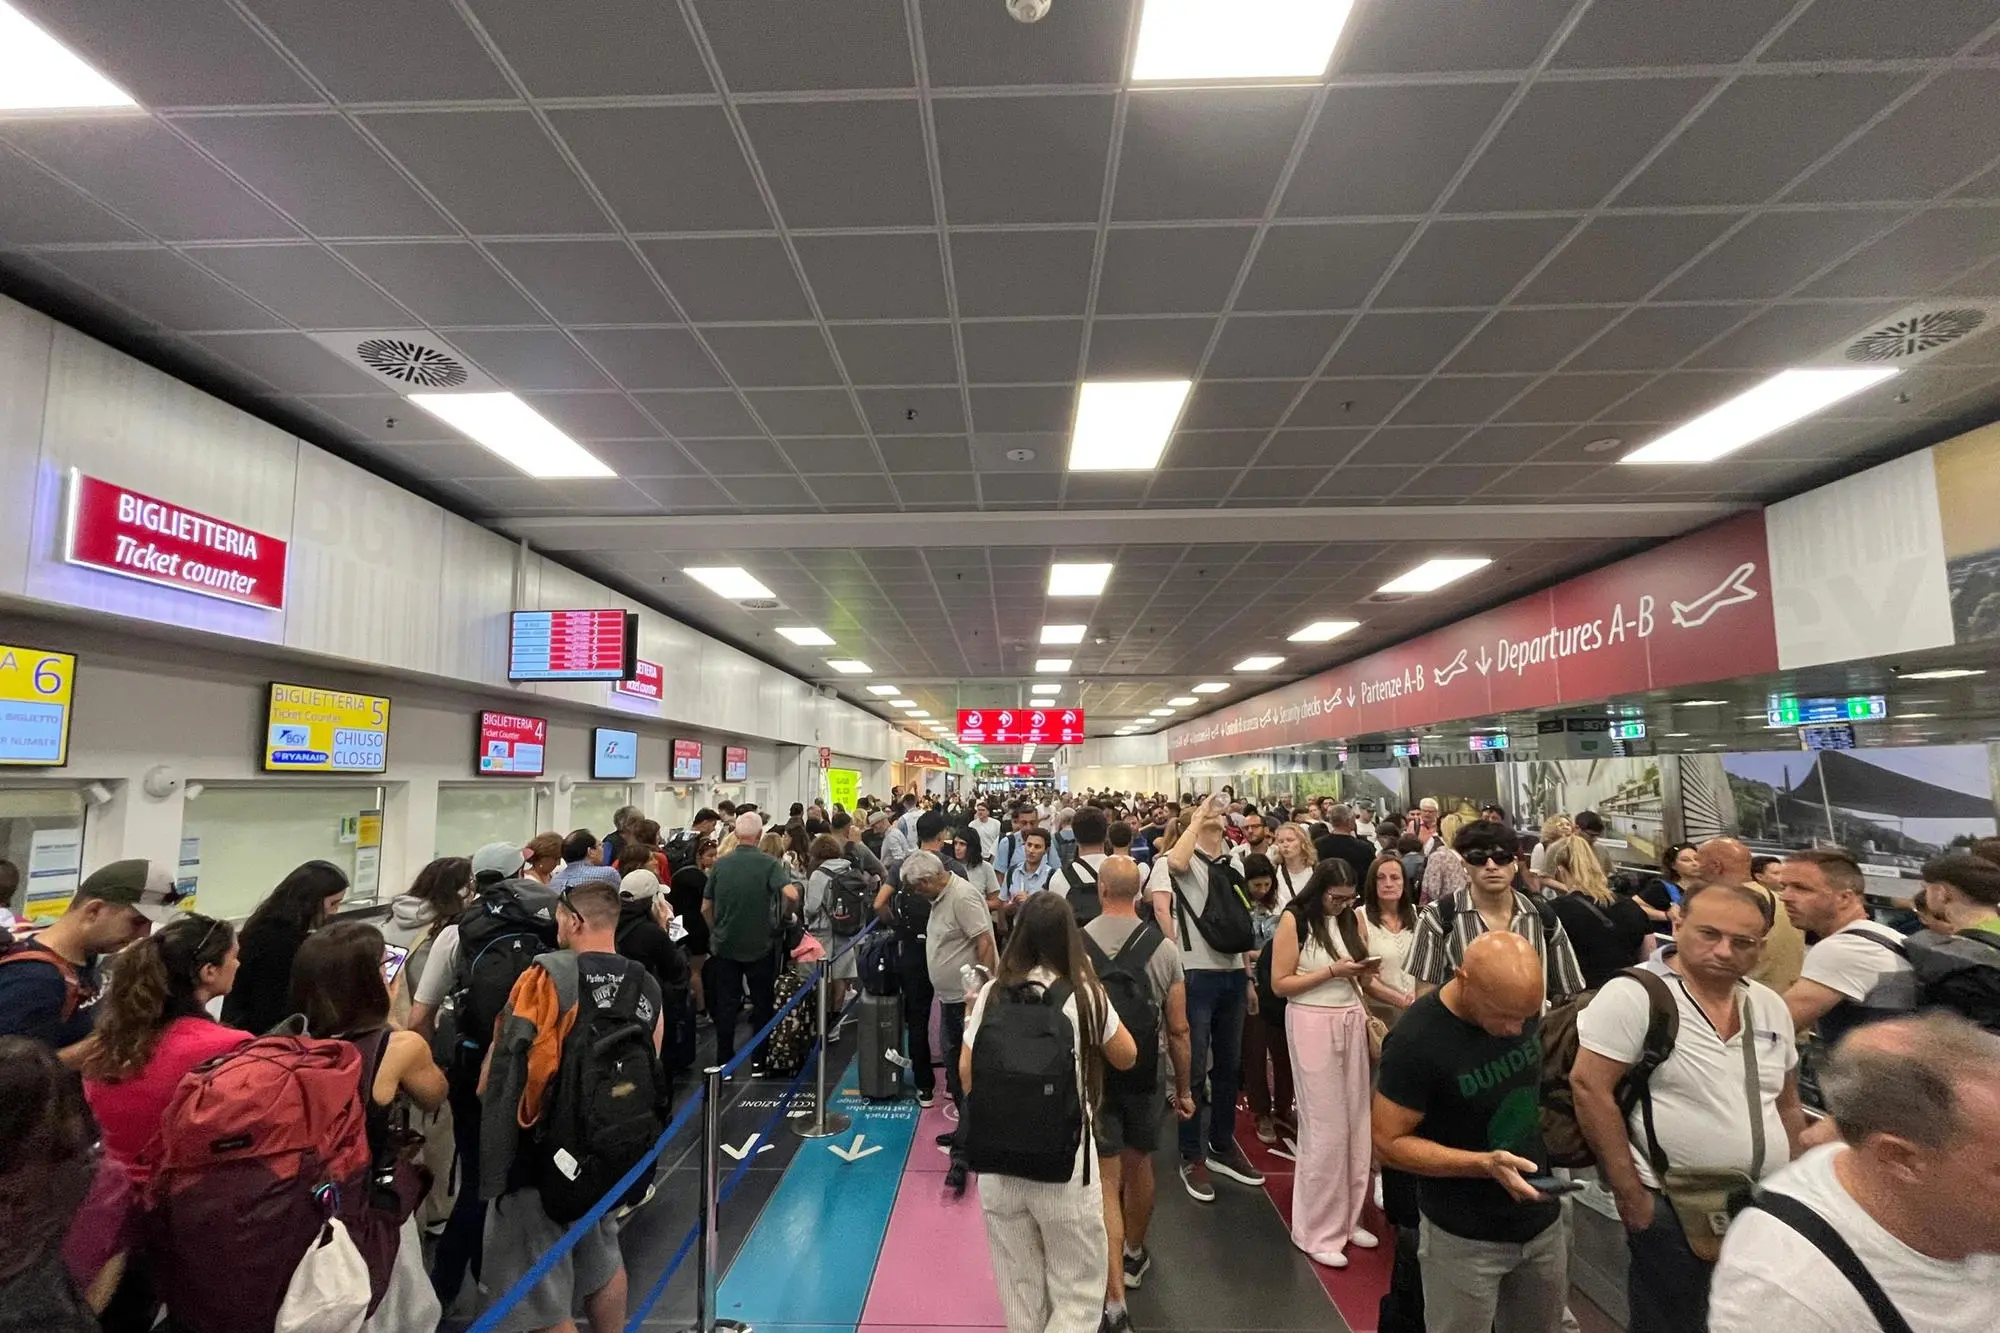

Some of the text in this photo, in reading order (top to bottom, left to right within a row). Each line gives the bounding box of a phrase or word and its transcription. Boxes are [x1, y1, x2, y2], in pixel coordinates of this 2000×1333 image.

[118, 493, 258, 560] BIGLIETTERIA
[115, 535, 257, 595] Ticket counter
[1498, 595, 1654, 675] Departures A-B
[33, 658, 62, 694] 6
[1361, 664, 1425, 704] Partenze A-B
[275, 687, 384, 726] BIGLIETTERIA 5
[1301, 695, 1321, 718] checks
[286, 734, 307, 745] BGY
[335, 731, 383, 748] CHIUSO
[483, 712, 544, 741] BIGLIETTERIA 4
[281, 752, 327, 762] RYANAIR
[334, 752, 382, 767] CLOSED
